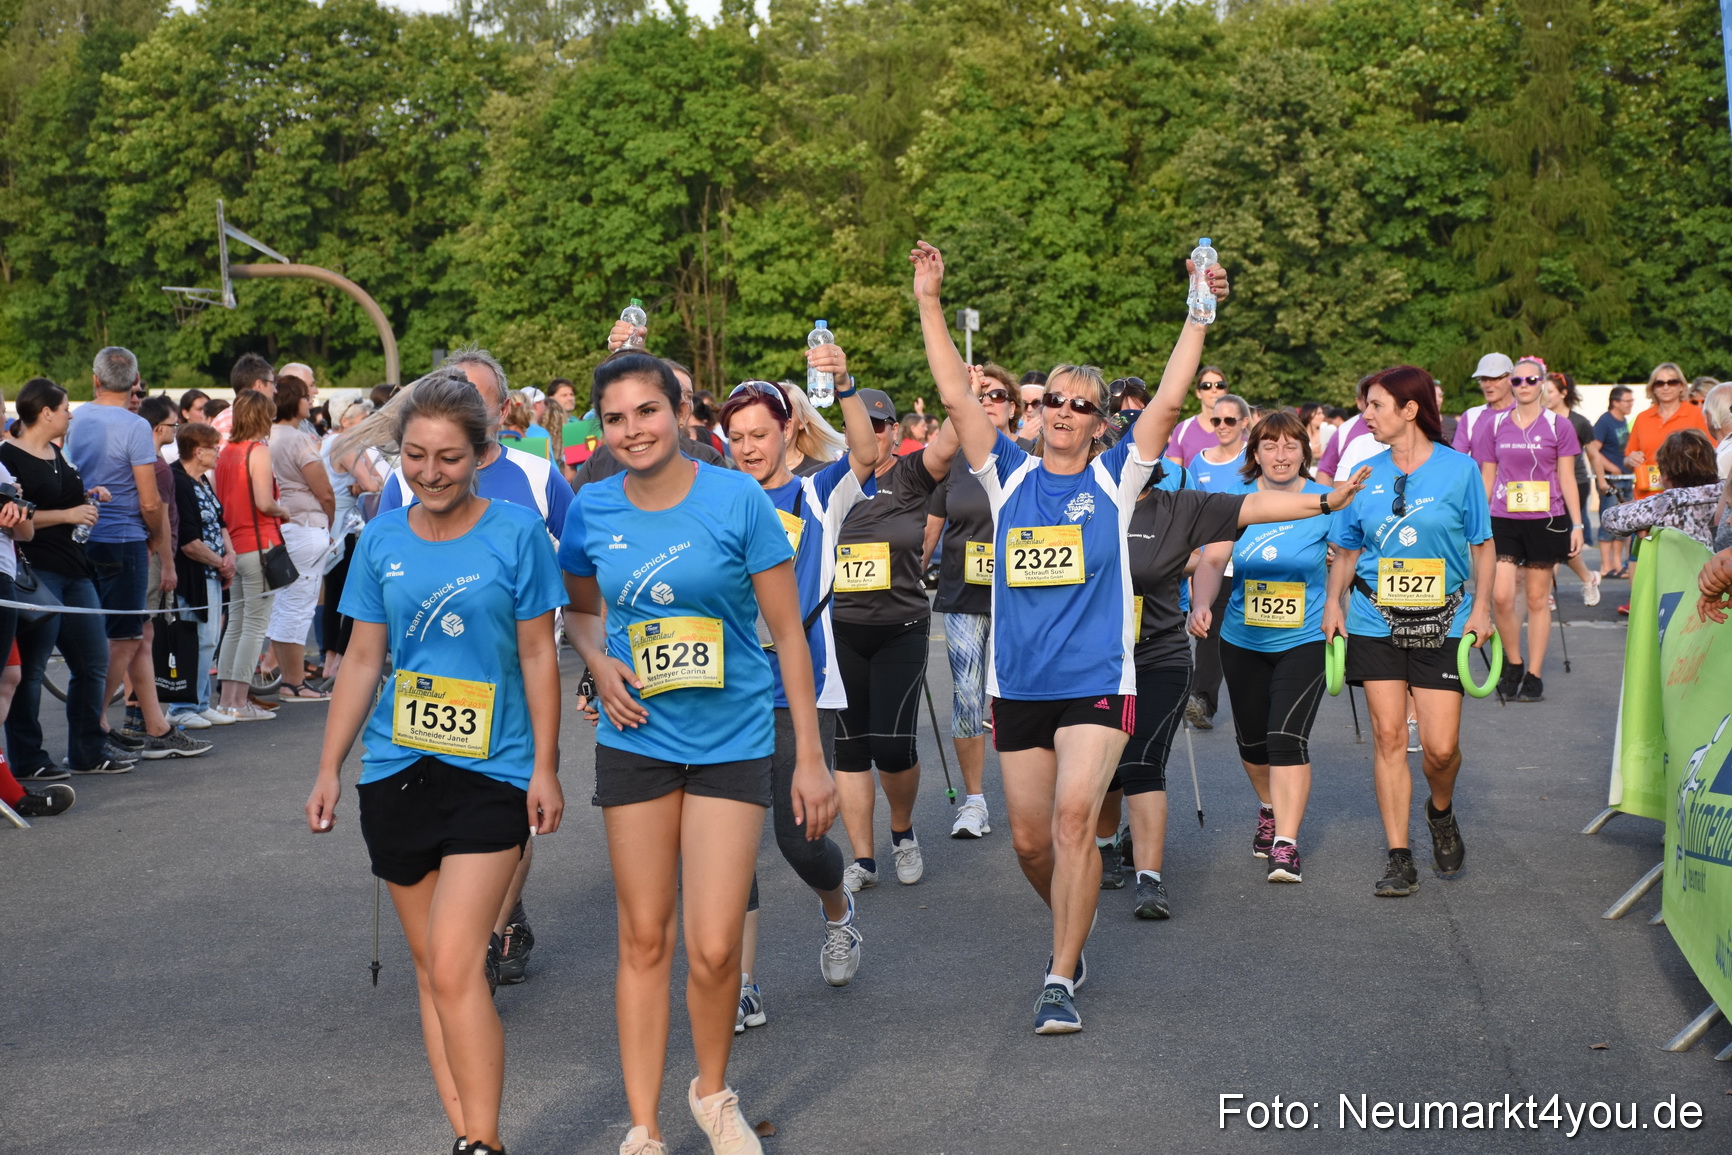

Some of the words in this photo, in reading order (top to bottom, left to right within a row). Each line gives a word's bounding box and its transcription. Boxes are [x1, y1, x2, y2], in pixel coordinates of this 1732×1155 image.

[1415, 496, 1434, 506] Bau
[1240, 541, 1255, 557] Team
[1254, 528, 1278, 543] Schick
[976, 558, 994, 573] 15
[1014, 547, 1073, 570] 2322
[617, 580, 634, 606] Team
[632, 552, 668, 579] Schick
[668, 540, 691, 554] Bau
[843, 561, 875, 578] 172
[1387, 576, 1435, 592] 1527
[406, 610, 424, 638] Team
[422, 582, 454, 610] Schick
[456, 574, 480, 586] Bau
[1252, 597, 1296, 615] 1525
[642, 642, 709, 674] 1528
[647, 670, 679, 682] Nestmeyer
[408, 685, 446, 699] firmenlauf
[406, 700, 476, 735] 1533
[410, 728, 445, 739] Schneider
[447, 734, 468, 743] Janet
